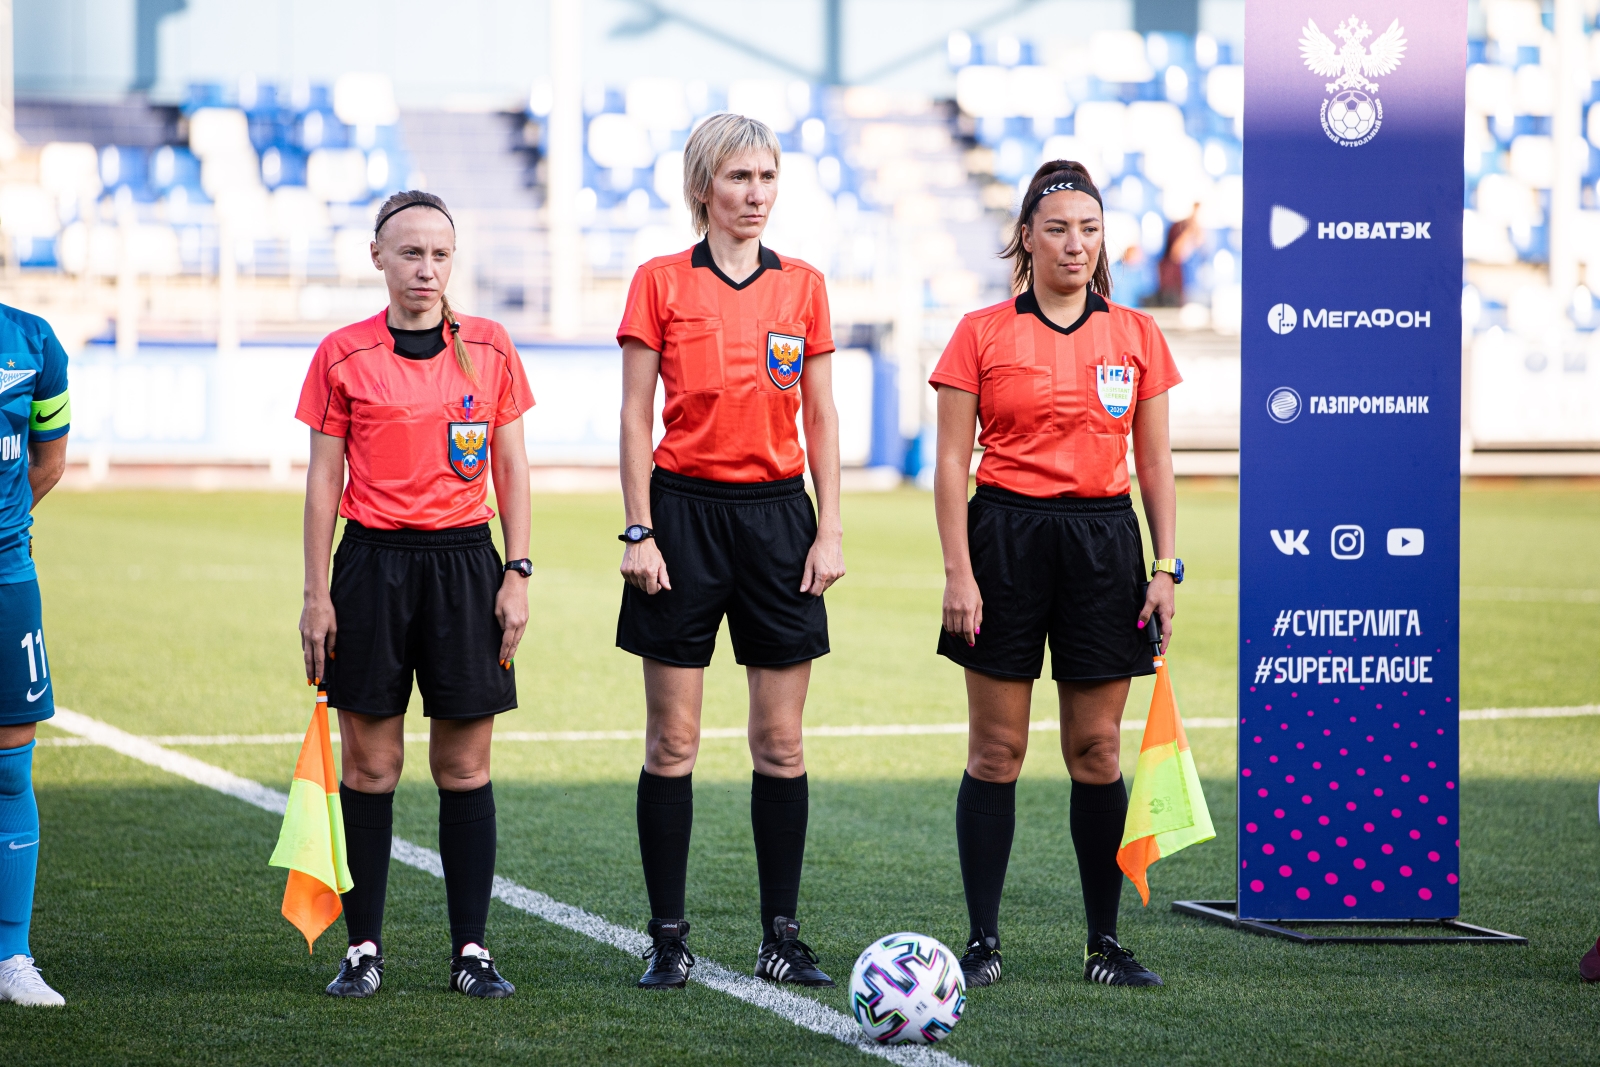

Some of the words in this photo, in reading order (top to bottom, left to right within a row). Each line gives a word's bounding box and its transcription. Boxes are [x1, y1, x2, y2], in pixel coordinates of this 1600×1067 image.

[1320, 98, 1340, 144] РОССИЙСКИЙ
[1339, 120, 1382, 148] ФУТБОЛЬНЫЙ
[1374, 98, 1383, 119] СОЮЗ
[1318, 222, 1431, 239] НОВАТЭК
[1310, 396, 1429, 414] ГАЗПРОМБАНК
[0, 433, 21, 461] ОМ
[1272, 609, 1421, 637] #СУПЕРЛИГА
[21, 629, 47, 683] 11
[1254, 656, 1433, 684] #SUPERLEAGUE
